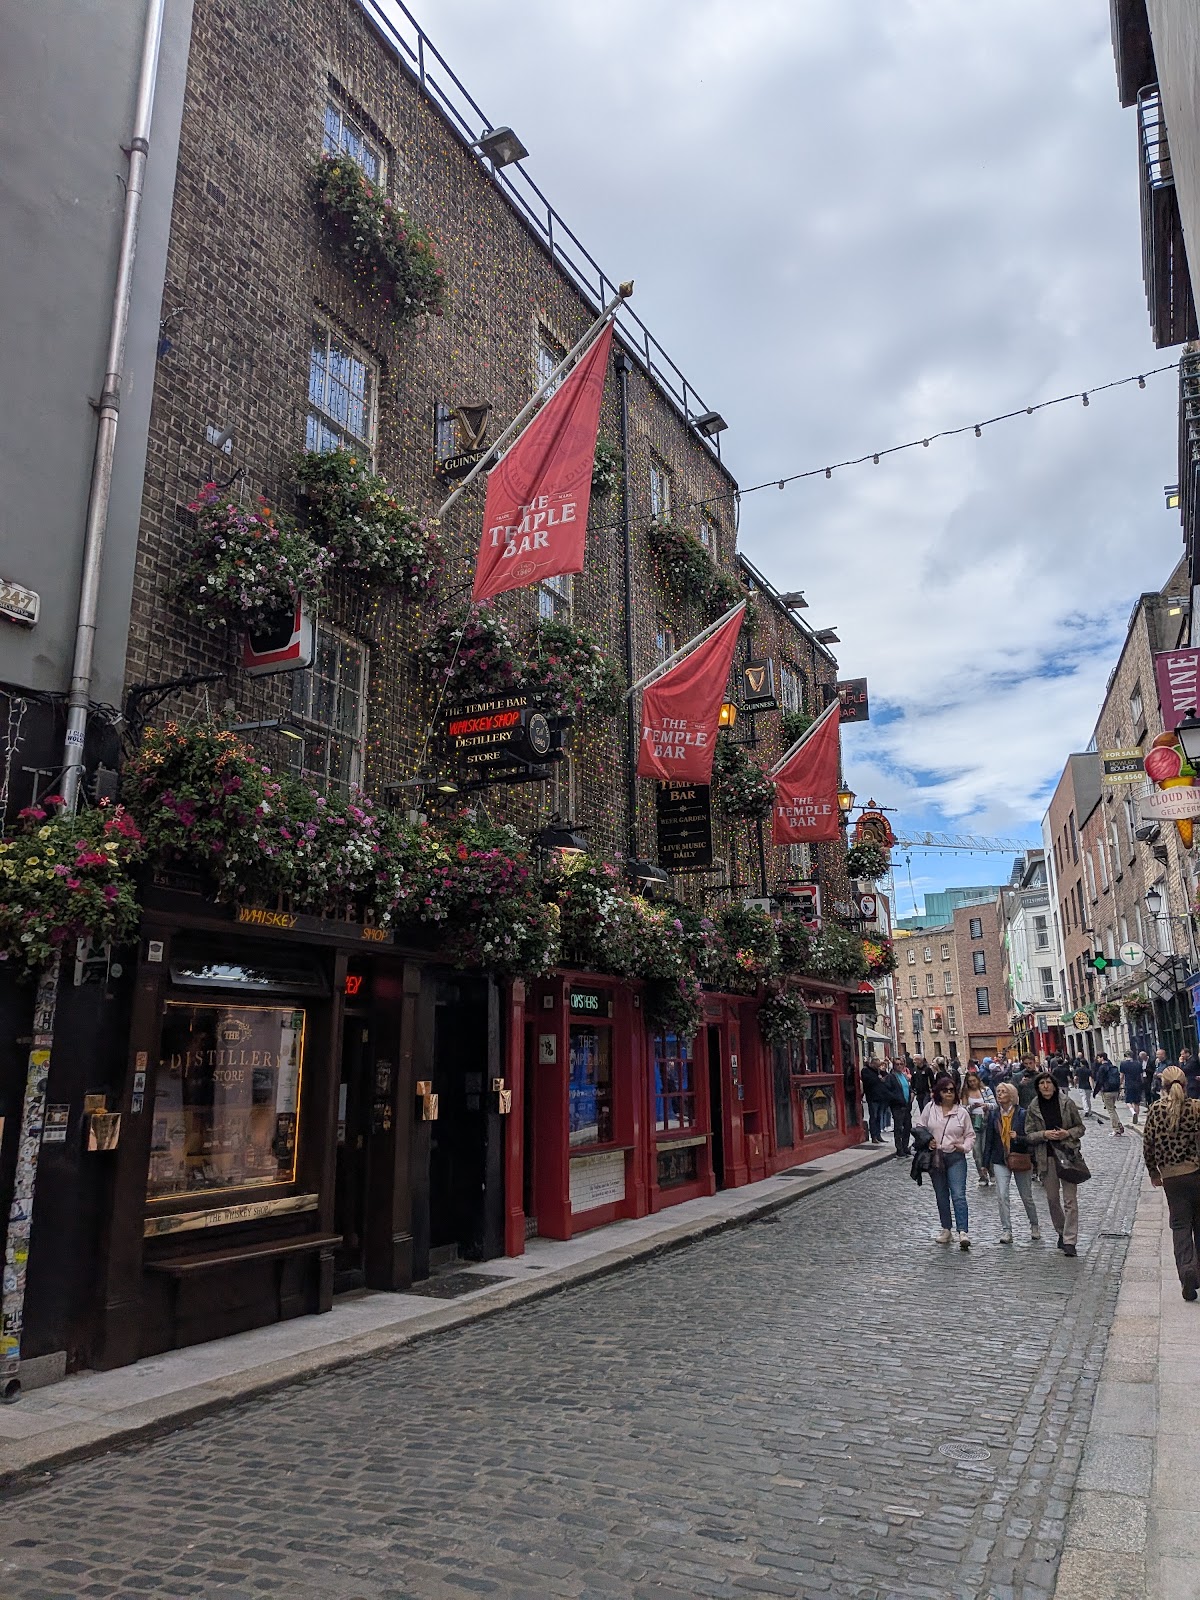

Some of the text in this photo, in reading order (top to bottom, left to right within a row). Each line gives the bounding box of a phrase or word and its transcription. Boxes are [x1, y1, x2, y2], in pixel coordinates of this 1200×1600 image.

[518, 495, 549, 518] THE
[489, 503, 577, 547] TEMPLE
[503, 531, 550, 559] BAR
[1167, 654, 1198, 712] NINE
[445, 696, 528, 717] THE TEMPLE BAR
[743, 701, 775, 711] GUINNESS
[449, 716, 493, 735] WHISKEY
[493, 711, 520, 728] SHOP
[662, 717, 688, 730] THE
[455, 731, 513, 748] DISTILLERY
[642, 726, 708, 747] TEMPLE
[467, 751, 502, 763] STORE
[653, 745, 686, 760] BAR
[1122, 749, 1140, 757] SALE
[1108, 773, 1142, 782] 456 4560
[670, 790, 696, 801] BAR
[792, 797, 813, 806] THE
[1149, 789, 1200, 807] CLOUD NI
[777, 804, 832, 817] TEMPLE
[678, 814, 706, 823] GARDEN
[790, 816, 817, 828] BAR
[664, 841, 706, 852] LIVE MUSIC
[673, 851, 697, 859] DAILY
[240, 907, 298, 928] WHISKEY
[361, 925, 388, 941] SHOP
[224, 1030, 239, 1040] THE
[578, 1035, 594, 1047] THE
[212, 1070, 245, 1082] STORE
[209, 1205, 269, 1223] THE WHISKEY SHOP
